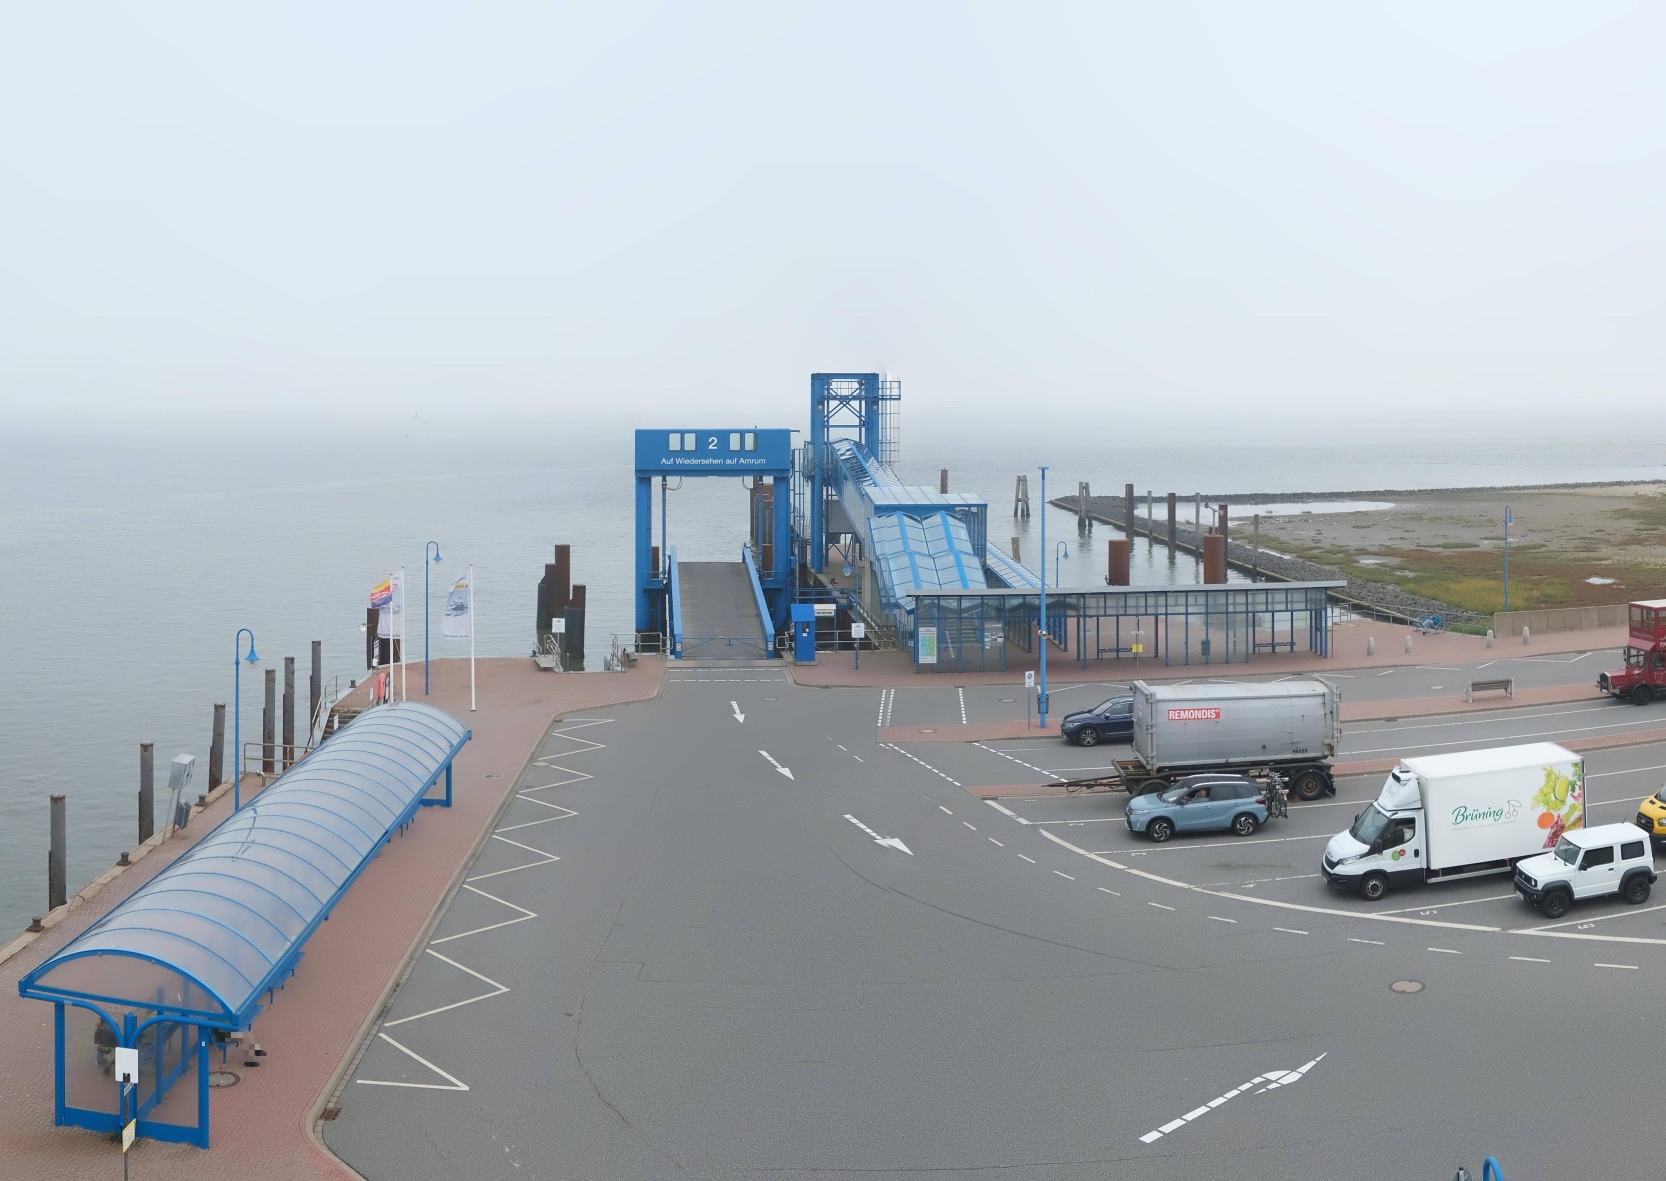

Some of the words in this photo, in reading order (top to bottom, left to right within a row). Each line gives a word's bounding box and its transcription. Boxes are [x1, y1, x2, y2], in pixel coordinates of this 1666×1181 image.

[708, 437, 718, 450] 2
[661, 457, 674, 465] Auf
[675, 457, 724, 465] Wiedersehen
[725, 457, 737, 465] auf
[739, 457, 767, 465] Amrum
[1452, 805, 1504, 826] Brüning
